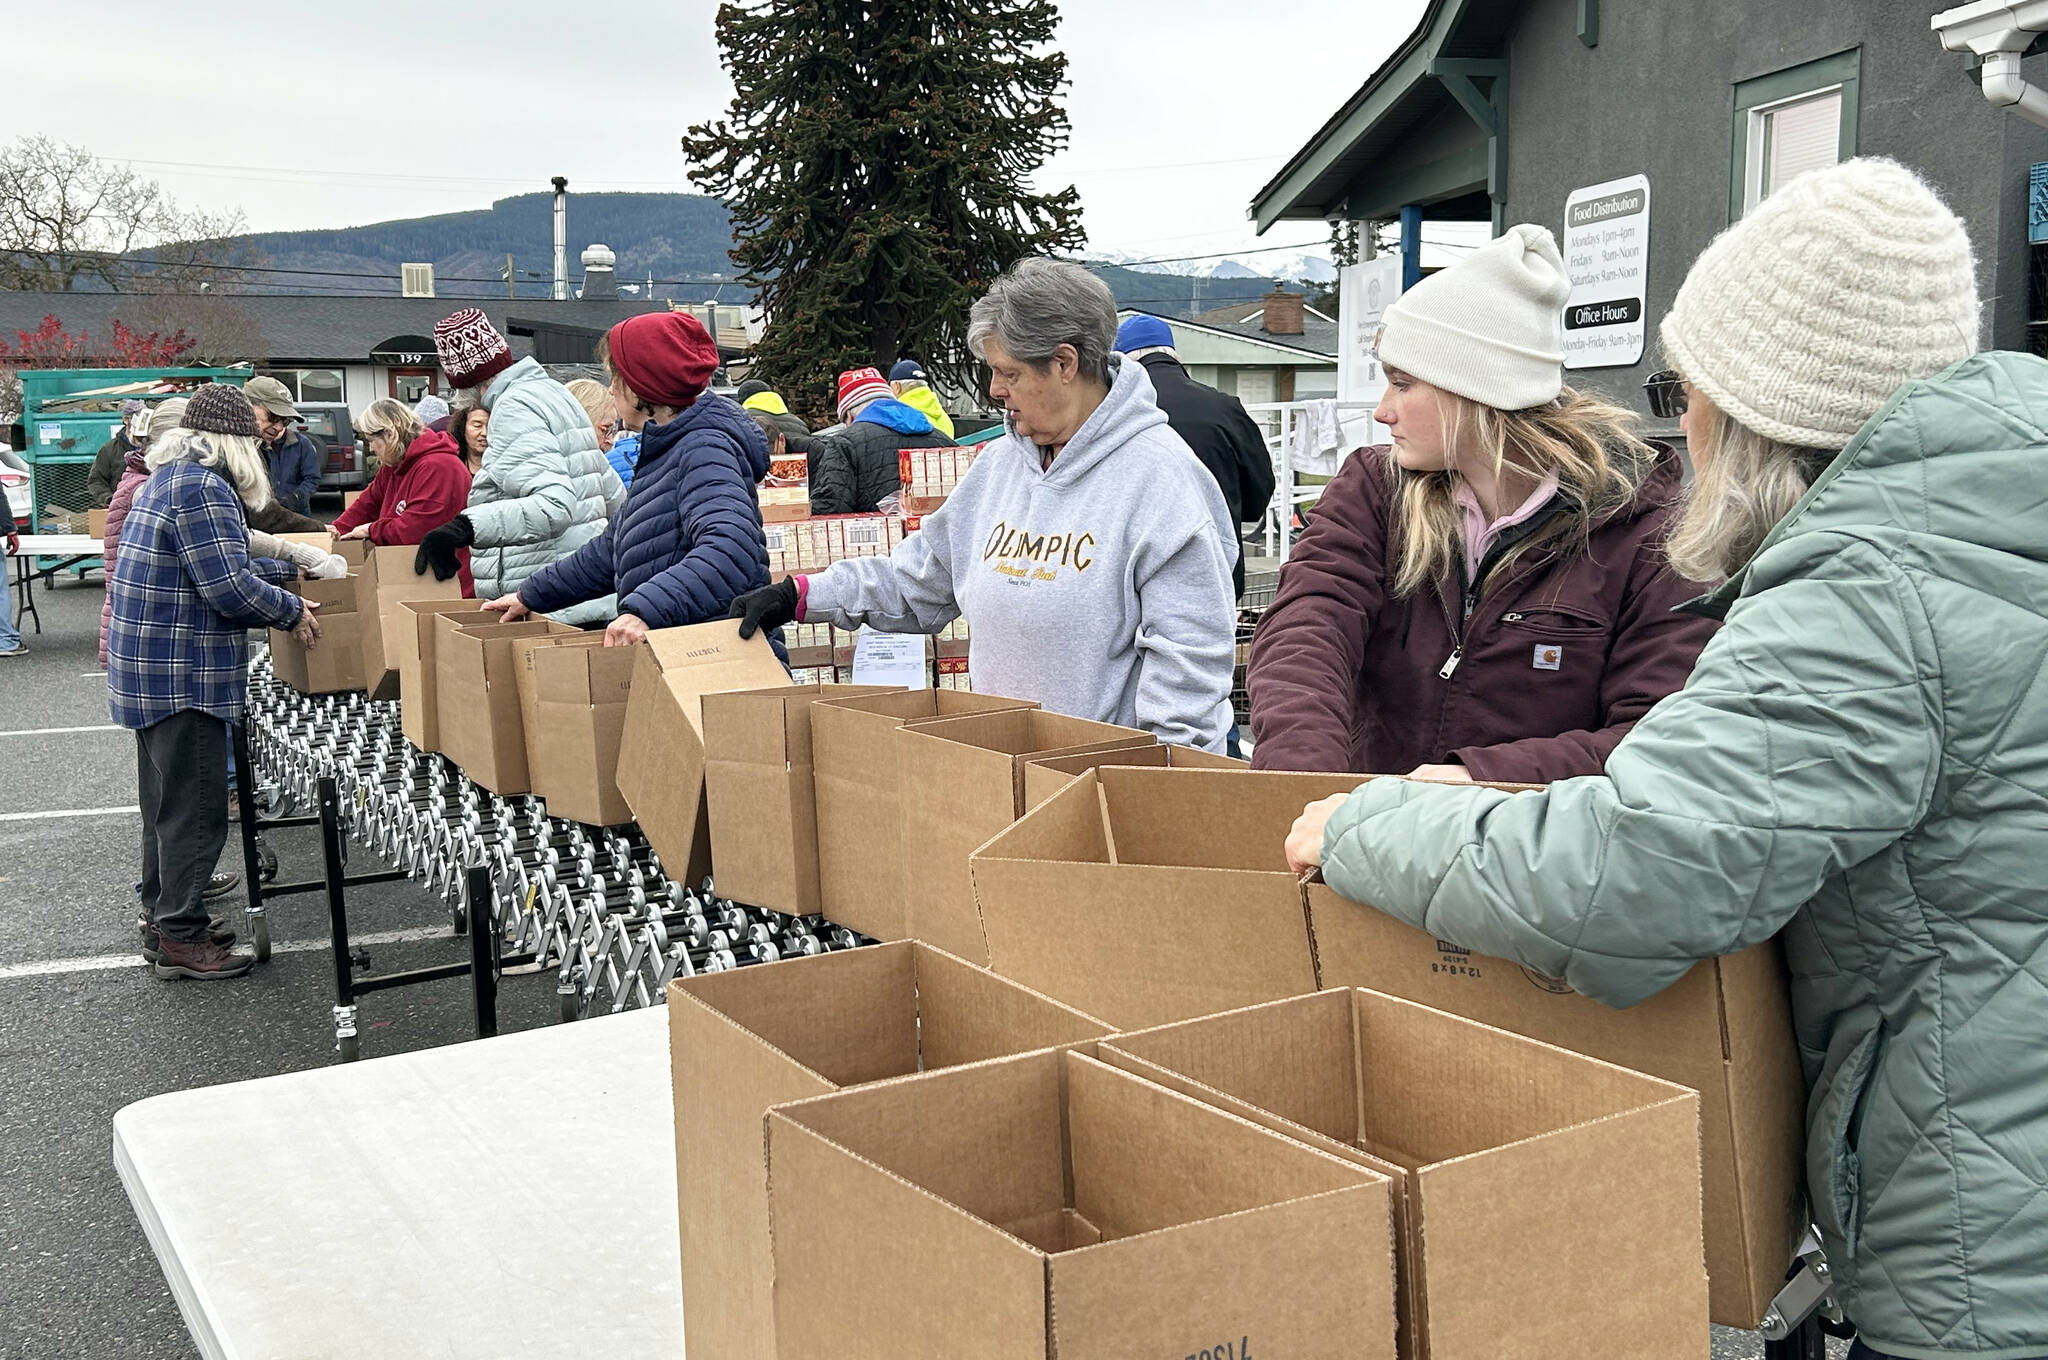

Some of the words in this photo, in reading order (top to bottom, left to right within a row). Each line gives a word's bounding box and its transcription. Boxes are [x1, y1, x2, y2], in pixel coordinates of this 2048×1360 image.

[1574, 203, 1592, 222] Food
[1593, 195, 1638, 217] Distribution
[1571, 232, 1600, 248] Mondays
[1571, 254, 1593, 268] Fridays
[1602, 246, 1639, 262] 9am-Noon
[1570, 271, 1600, 288] Saturdays
[1601, 267, 1638, 281] 9am-Noon
[1575, 306, 1601, 325] Office
[1602, 305, 1628, 322] Hours
[1609, 332, 1642, 349] 9am-3pm
[400, 354, 422, 364] 139
[984, 520, 1096, 573] OLYMPIC
[993, 561, 1029, 578] National
[1031, 566, 1057, 581] Park
[1432, 963, 1439, 972] 8
[1450, 965, 1457, 975] 8
[1469, 967, 1482, 978] 12
